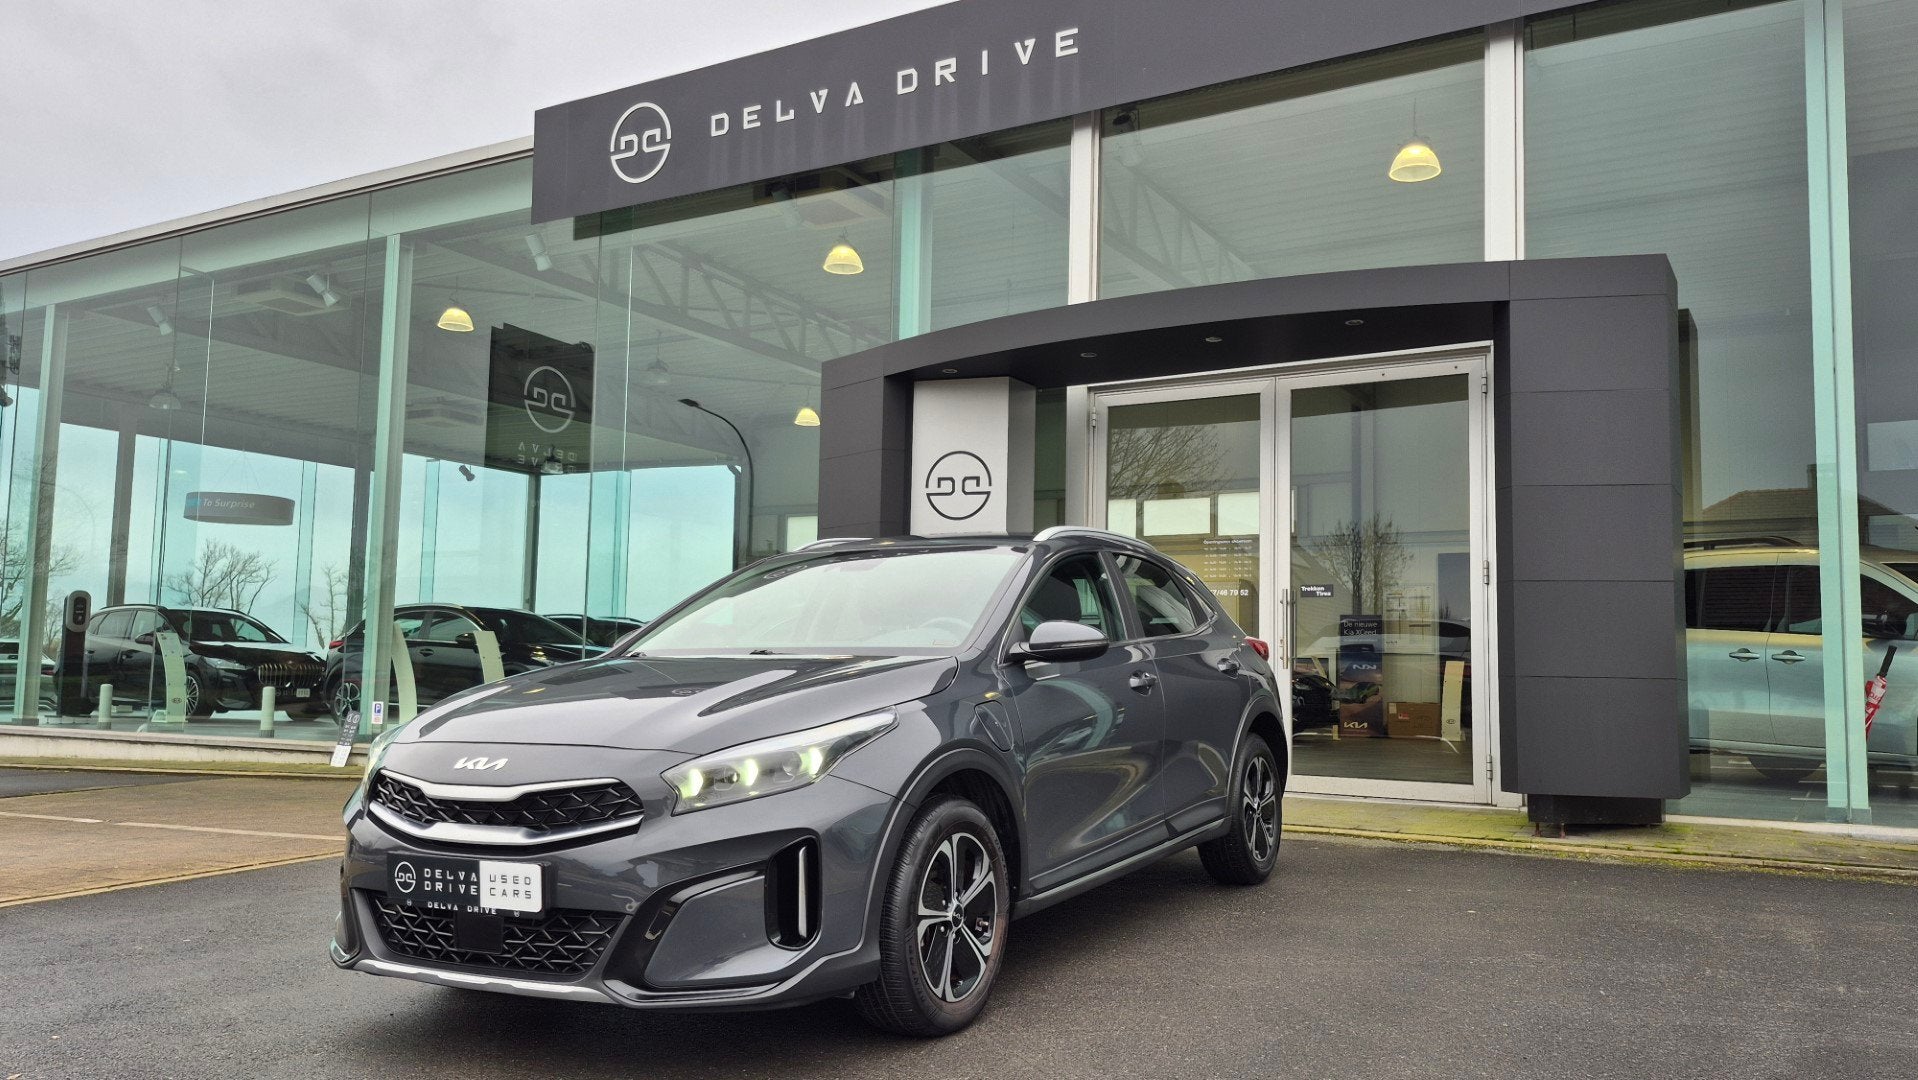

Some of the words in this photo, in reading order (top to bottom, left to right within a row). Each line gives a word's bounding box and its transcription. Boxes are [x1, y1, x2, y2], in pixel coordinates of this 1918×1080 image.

[711, 82, 864, 137] DELVA
[897, 28, 1079, 95] DRIVE
[203, 498, 212, 507] To
[214, 498, 255, 509] Surprise
[424, 868, 478, 882] DELVA
[489, 874, 532, 886] USED
[424, 881, 478, 895] DRIVE
[489, 887, 532, 899] CARS
[427, 901, 459, 911] DELVA
[467, 905, 498, 915] DRIVE
